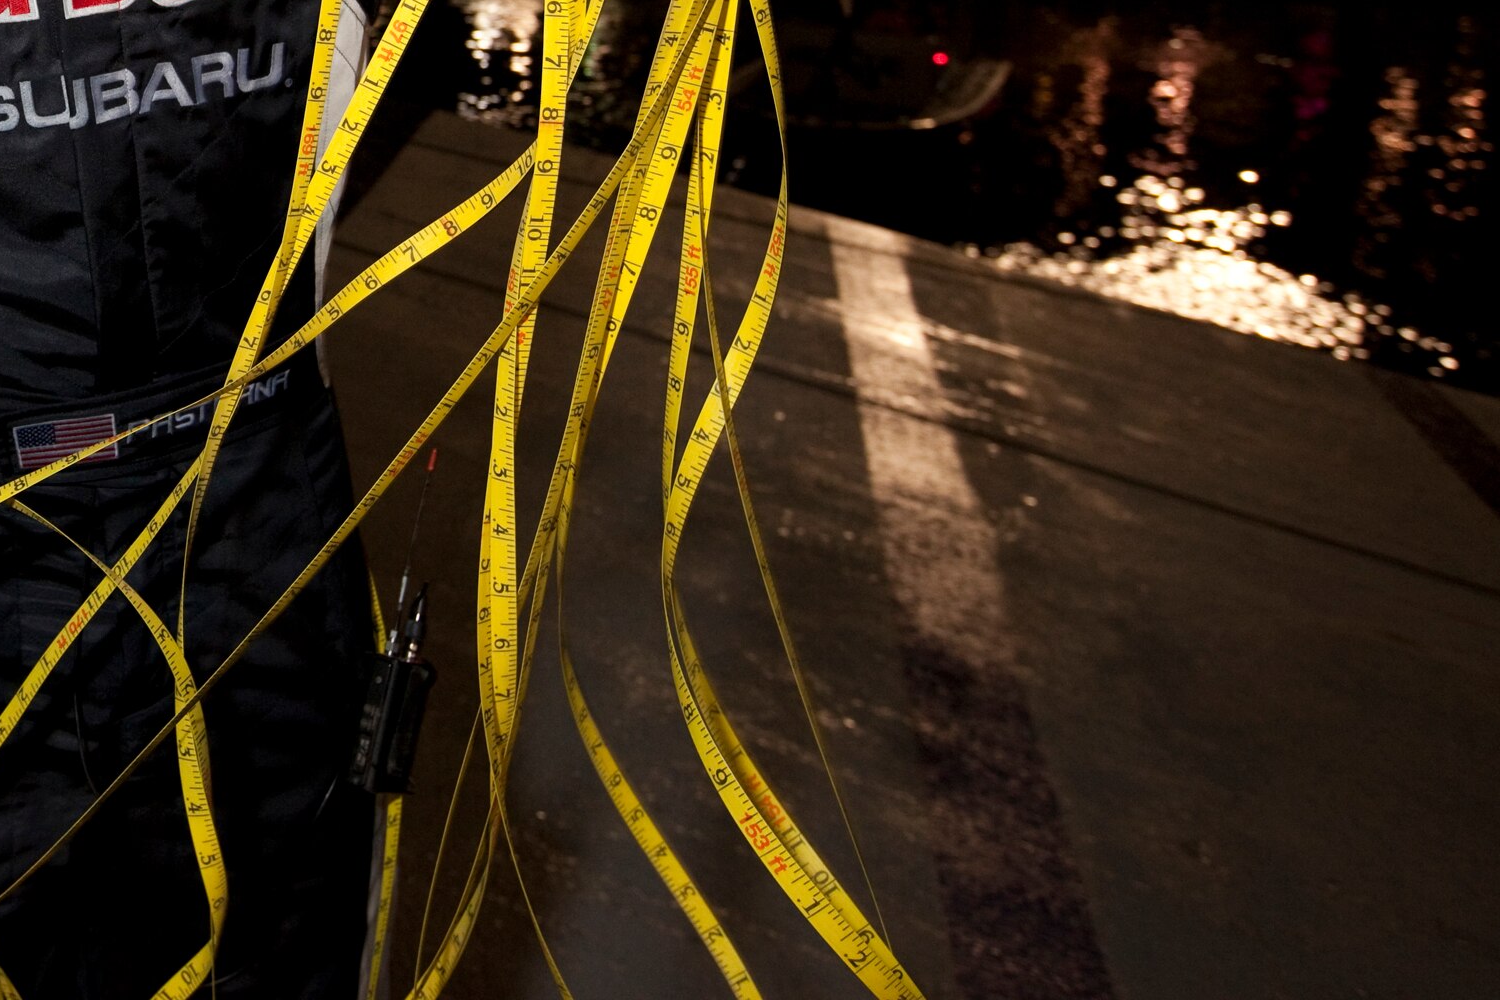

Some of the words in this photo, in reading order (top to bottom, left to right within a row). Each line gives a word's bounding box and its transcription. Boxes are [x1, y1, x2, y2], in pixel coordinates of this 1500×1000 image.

[389, 19, 408, 44] 97
[664, 34, 678, 48] 4
[377, 46, 394, 63] ft
[545, 54, 562, 68] 7
[678, 88, 696, 112] 54
[688, 65, 704, 80] ft
[542, 106, 559, 121] 8
[343, 118, 360, 132] 2
[302, 126, 317, 156] 169
[298, 163, 310, 177] ft
[321, 159, 337, 174] 3
[443, 218, 458, 237] 8
[527, 214, 545, 242] 10
[402, 246, 417, 263] 7
[687, 245, 702, 259] ft
[764, 262, 776, 278] ft
[685, 266, 699, 297] 155
[327, 304, 341, 320] 5
[735, 335, 752, 351] 2
[68, 607, 88, 635] 170
[56, 635, 69, 650] ft
[739, 812, 770, 852] 153
[767, 855, 788, 876] ft
